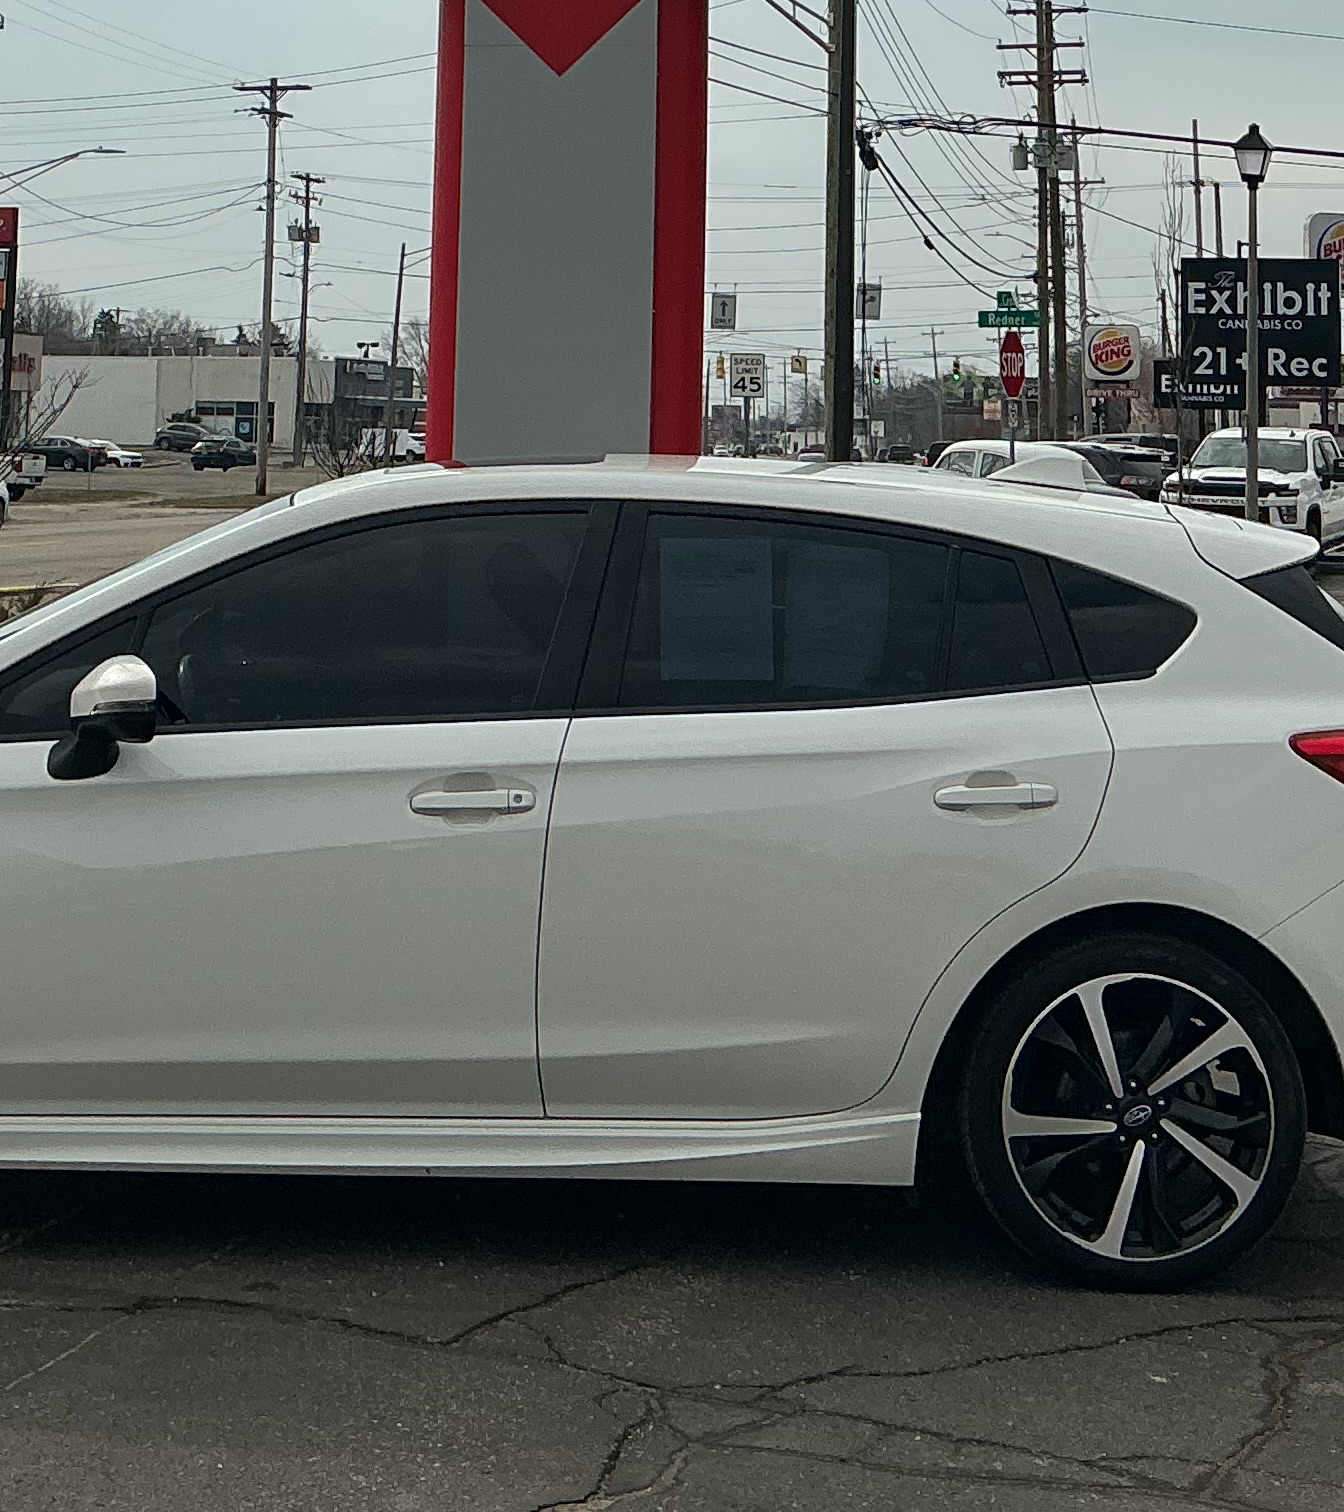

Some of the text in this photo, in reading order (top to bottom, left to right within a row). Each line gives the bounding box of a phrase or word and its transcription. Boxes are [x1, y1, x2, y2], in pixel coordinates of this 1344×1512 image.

[1186, 281, 1332, 317] Exhibit
[987, 313, 1026, 326] Redner
[1218, 318, 1303, 331] CANABIS CO
[1092, 335, 1130, 353] BURGER
[733, 357, 762, 366] SPEED
[1094, 344, 1132, 366] KING
[1267, 347, 1328, 378] Rec
[735, 367, 759, 375] LIMIT
[1001, 352, 1024, 378] STOP
[732, 376, 762, 393] 45
